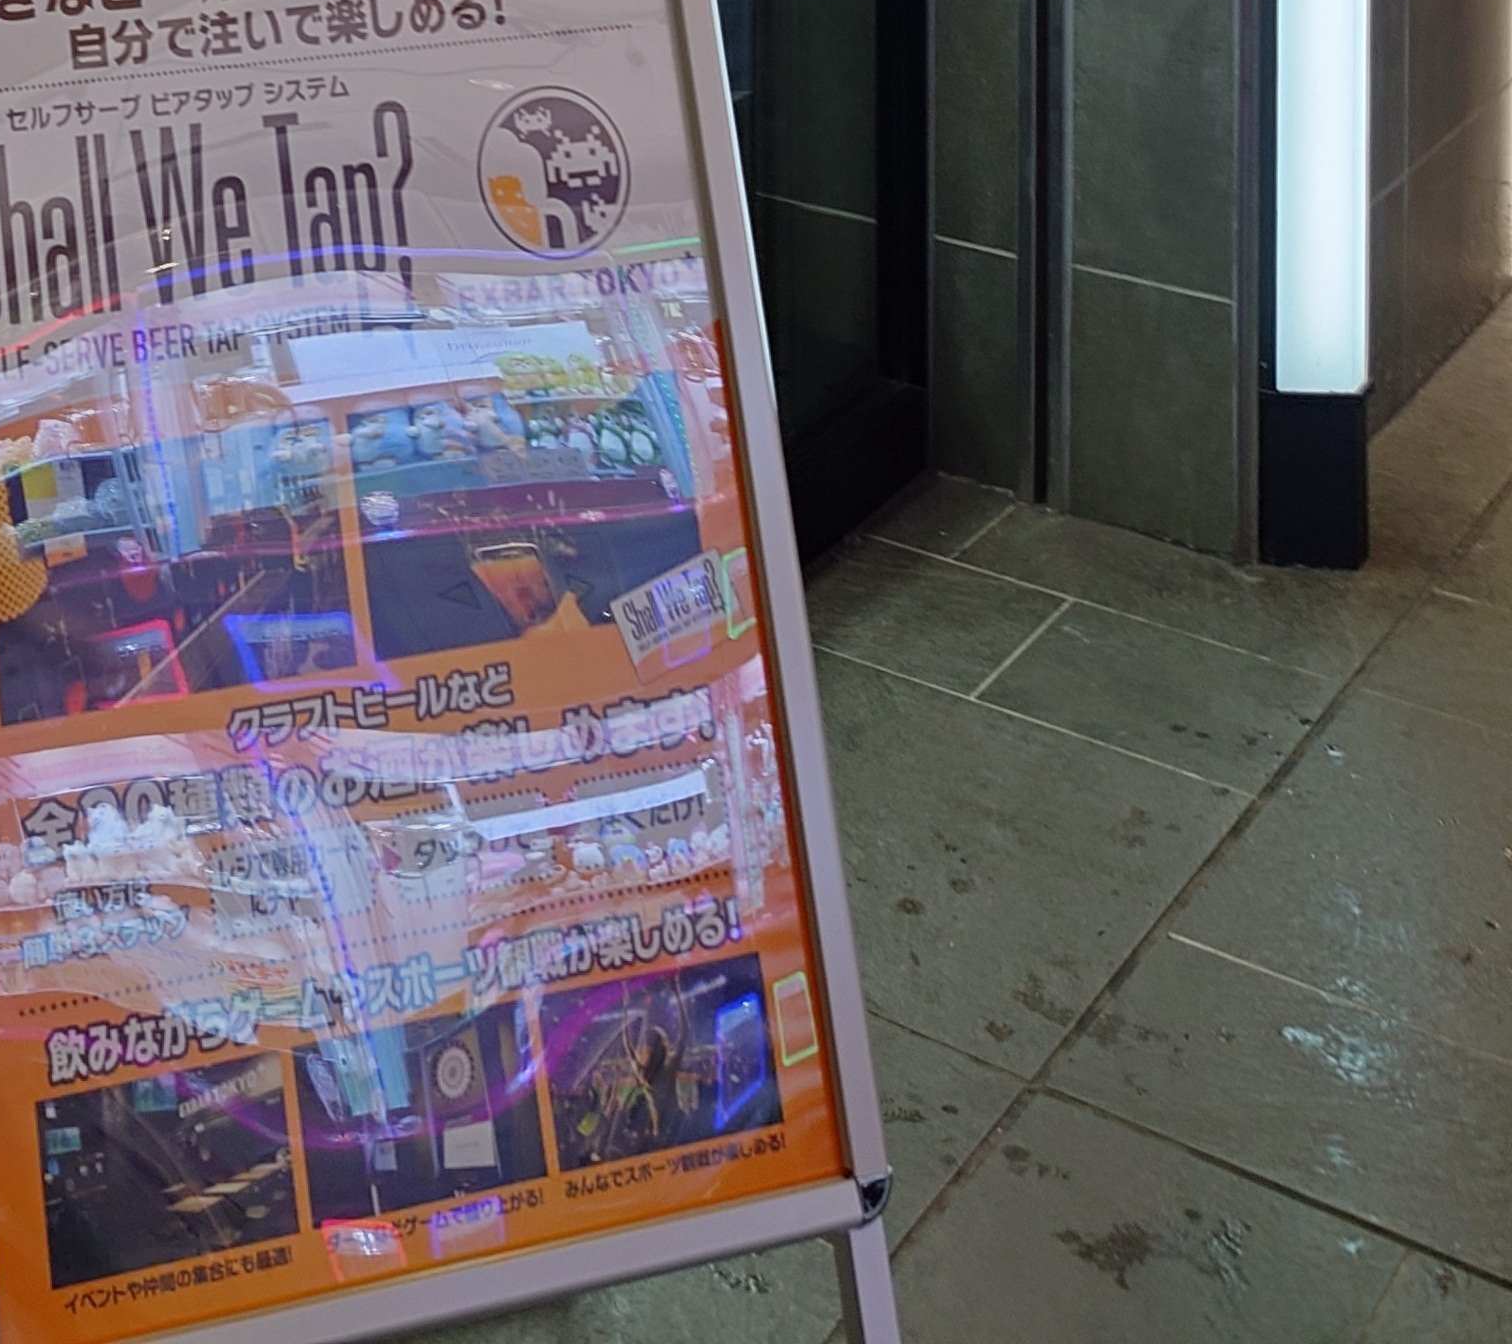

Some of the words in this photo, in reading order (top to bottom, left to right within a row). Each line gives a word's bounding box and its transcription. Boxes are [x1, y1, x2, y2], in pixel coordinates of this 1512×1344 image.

[130, 122, 255, 306] We
[263, 101, 415, 340] Tap?
[132, 326, 196, 363] BEER
[205, 318, 241, 353] TAP
[622, 589, 665, 641] Shall
[228, 664, 515, 750] クラフトビールなど
